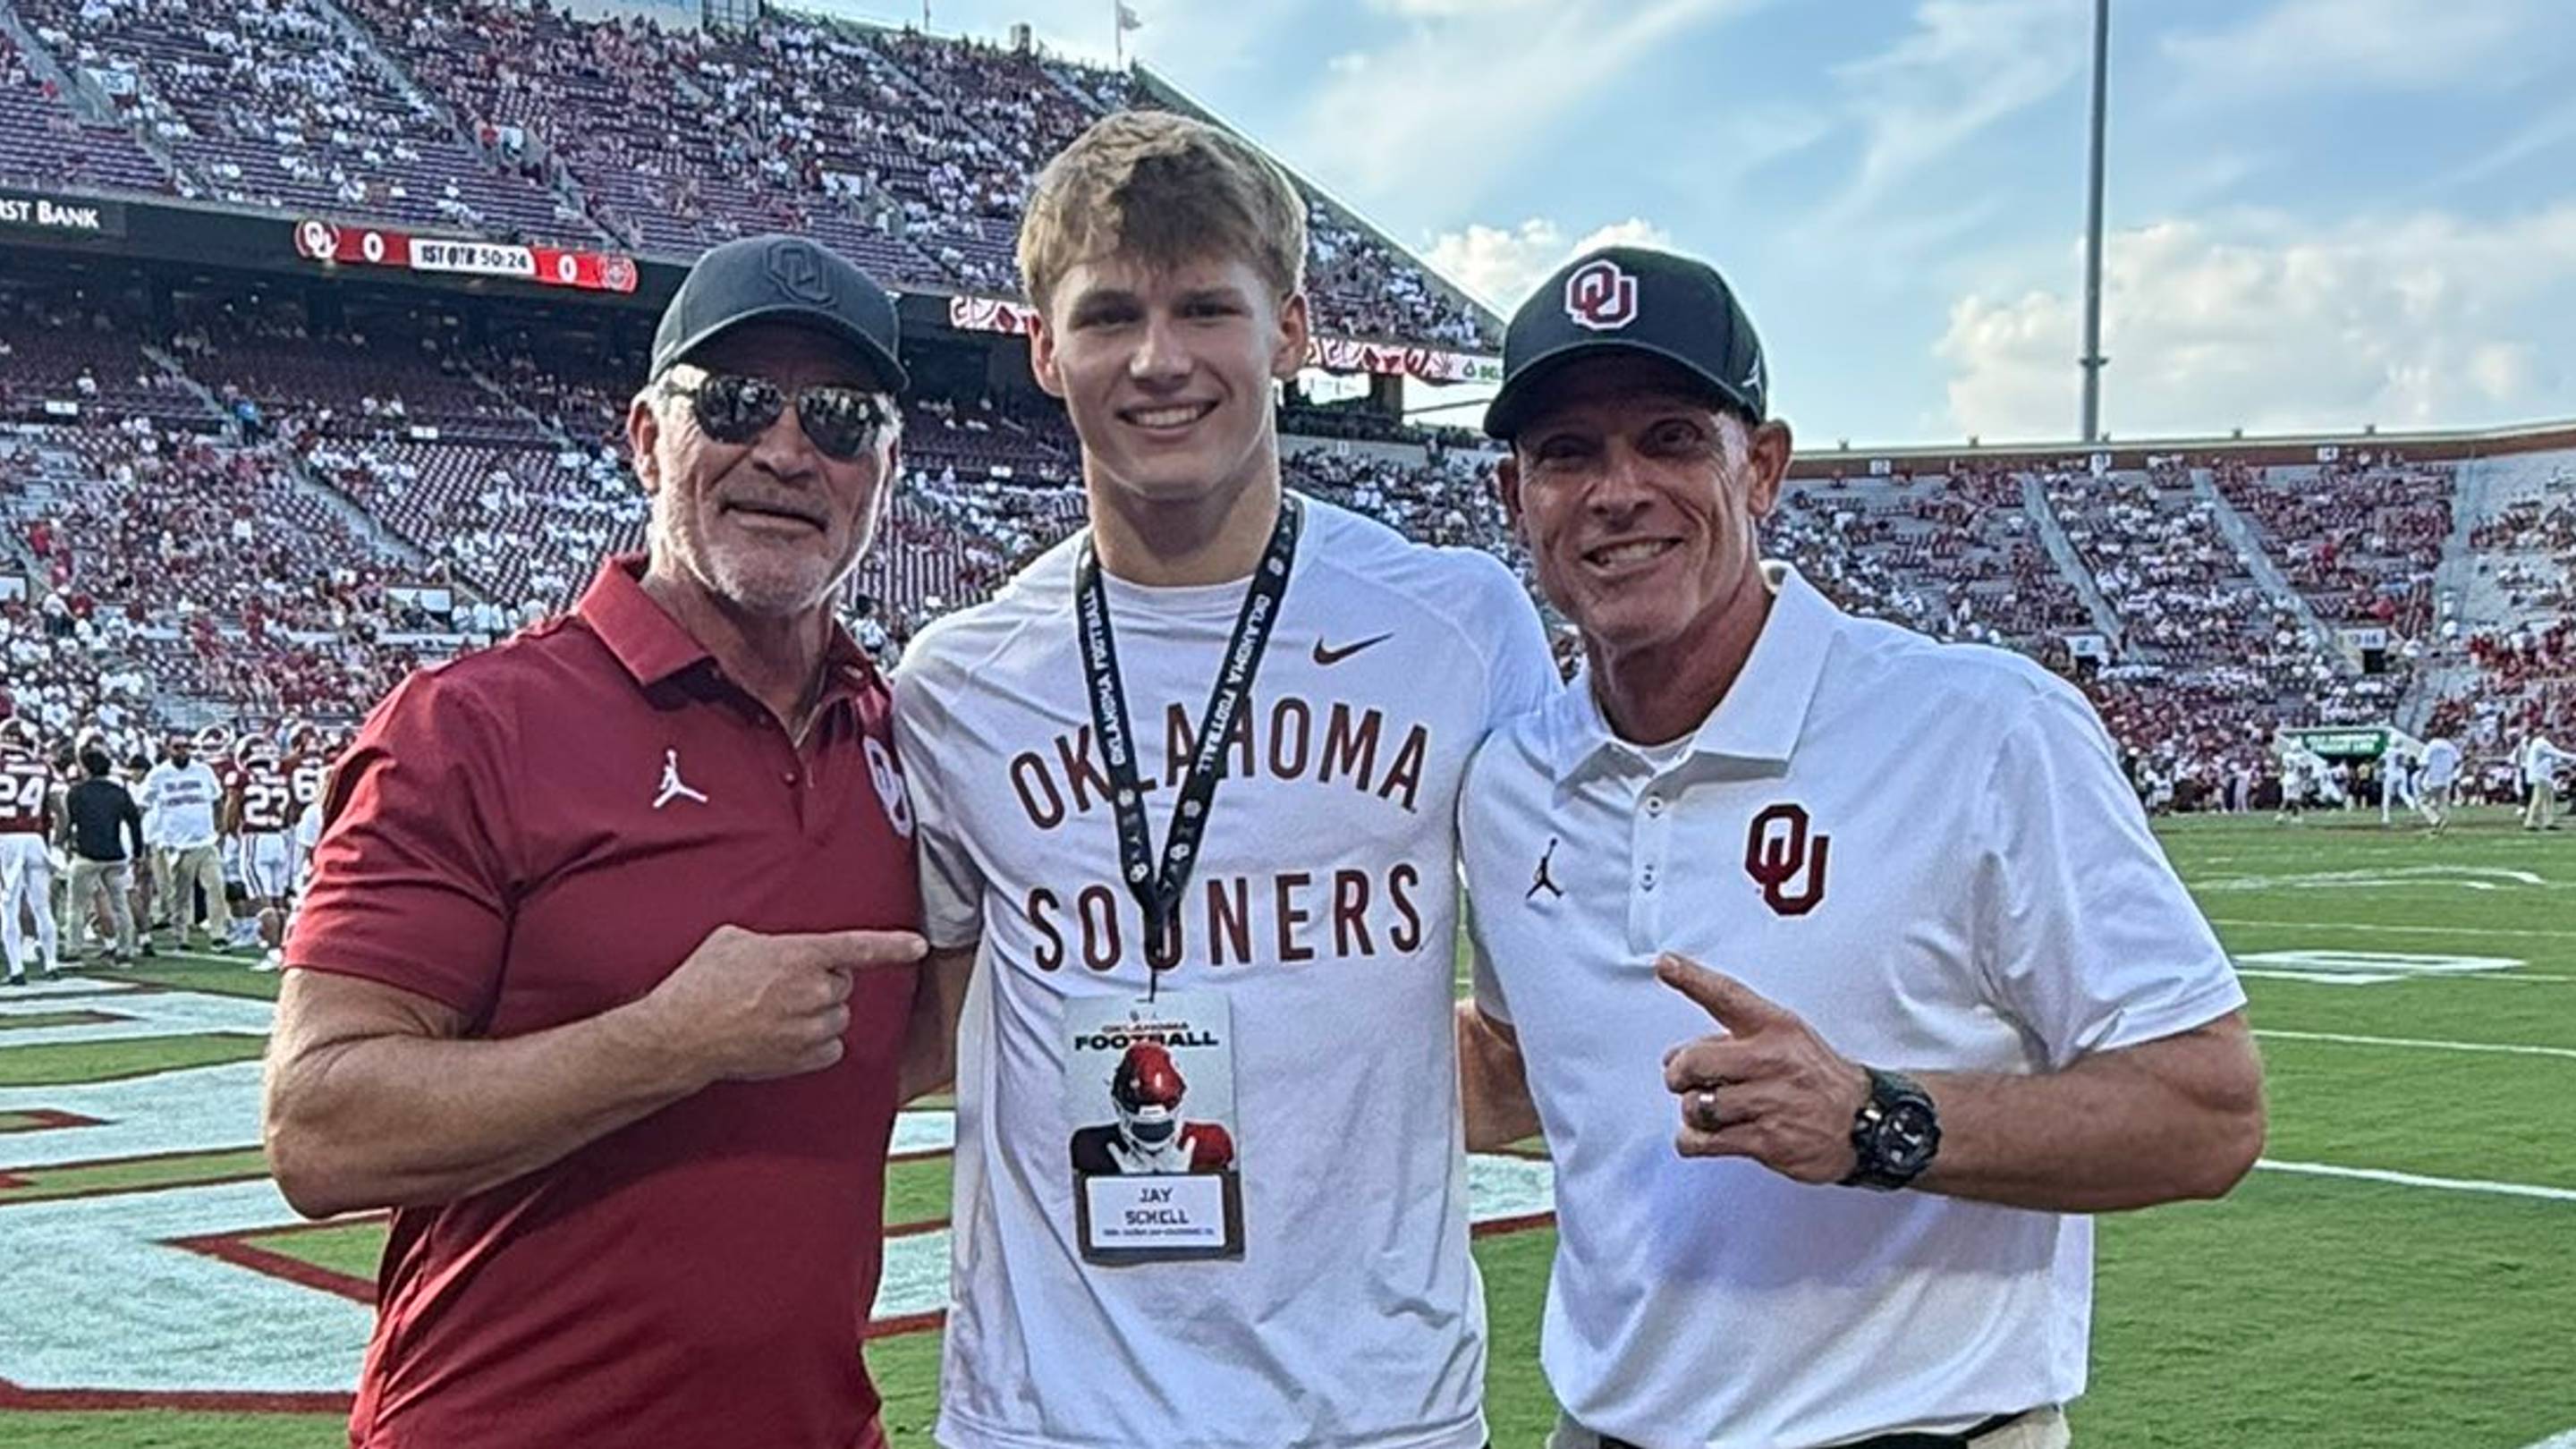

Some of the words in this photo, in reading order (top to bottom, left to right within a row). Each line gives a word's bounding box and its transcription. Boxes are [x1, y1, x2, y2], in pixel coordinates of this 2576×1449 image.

[37, 199, 99, 229] BANK
[363, 231, 385, 263] 0
[420, 244, 444, 265] 1ST
[480, 250, 528, 269] 50:24
[557, 254, 578, 284] 0
[1566, 258, 1638, 330] OU
[1082, 586, 1109, 671] FOOTBALL
[1226, 593, 1271, 684] OKLAHOMA
[1097, 673, 1126, 766] OKLAHOMA
[1195, 688, 1238, 775] FOOTBALL
[1010, 696, 1428, 829] OKAHOMA
[1745, 802, 1831, 918] OU
[1139, 1187, 1174, 1203] JAY
